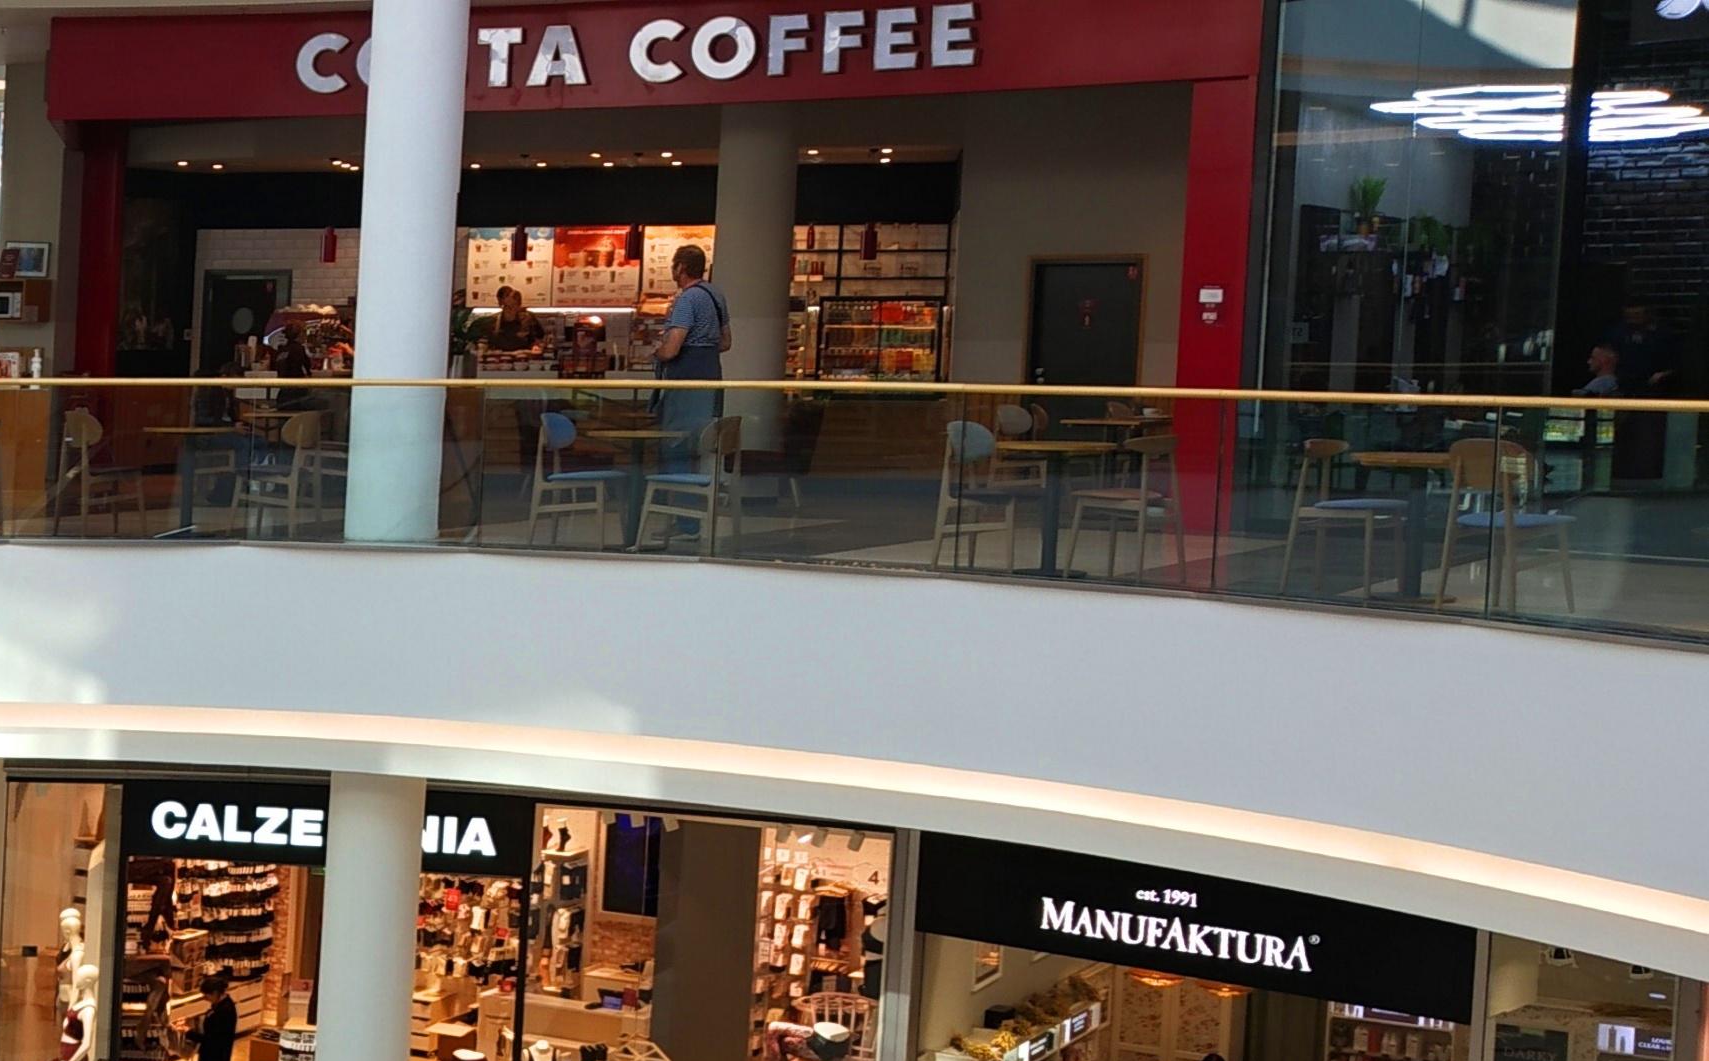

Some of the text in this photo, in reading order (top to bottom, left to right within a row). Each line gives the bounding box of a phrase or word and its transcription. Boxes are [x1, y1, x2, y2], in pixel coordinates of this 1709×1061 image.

[296, 3, 979, 94] CTA COFFEE
[151, 801, 497, 857] CALZENIA
[1136, 888, 1198, 908] est. 1991
